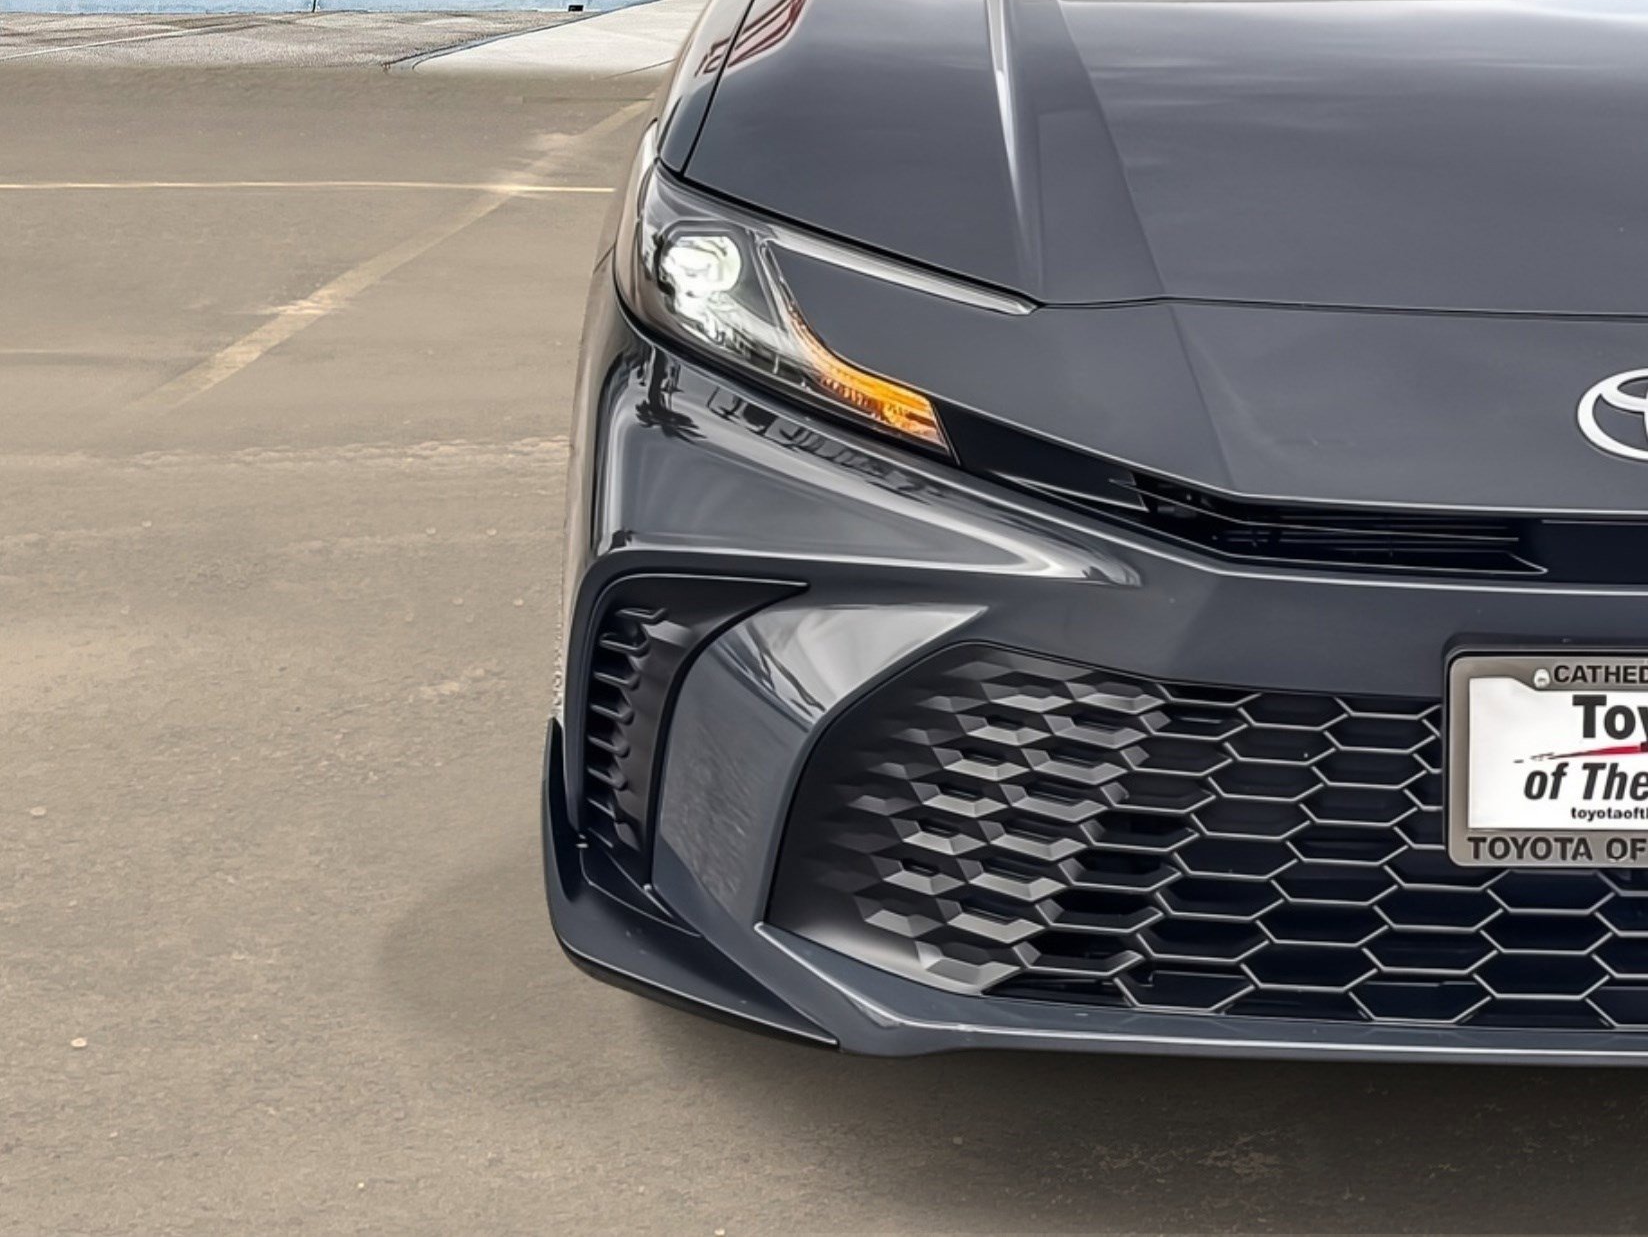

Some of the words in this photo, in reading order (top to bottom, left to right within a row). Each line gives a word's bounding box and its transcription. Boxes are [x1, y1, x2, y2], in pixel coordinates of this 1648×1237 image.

[1523, 762, 1568, 800] of
[1466, 835, 1593, 861] TOYOTA
[1605, 836, 1648, 862] OF
